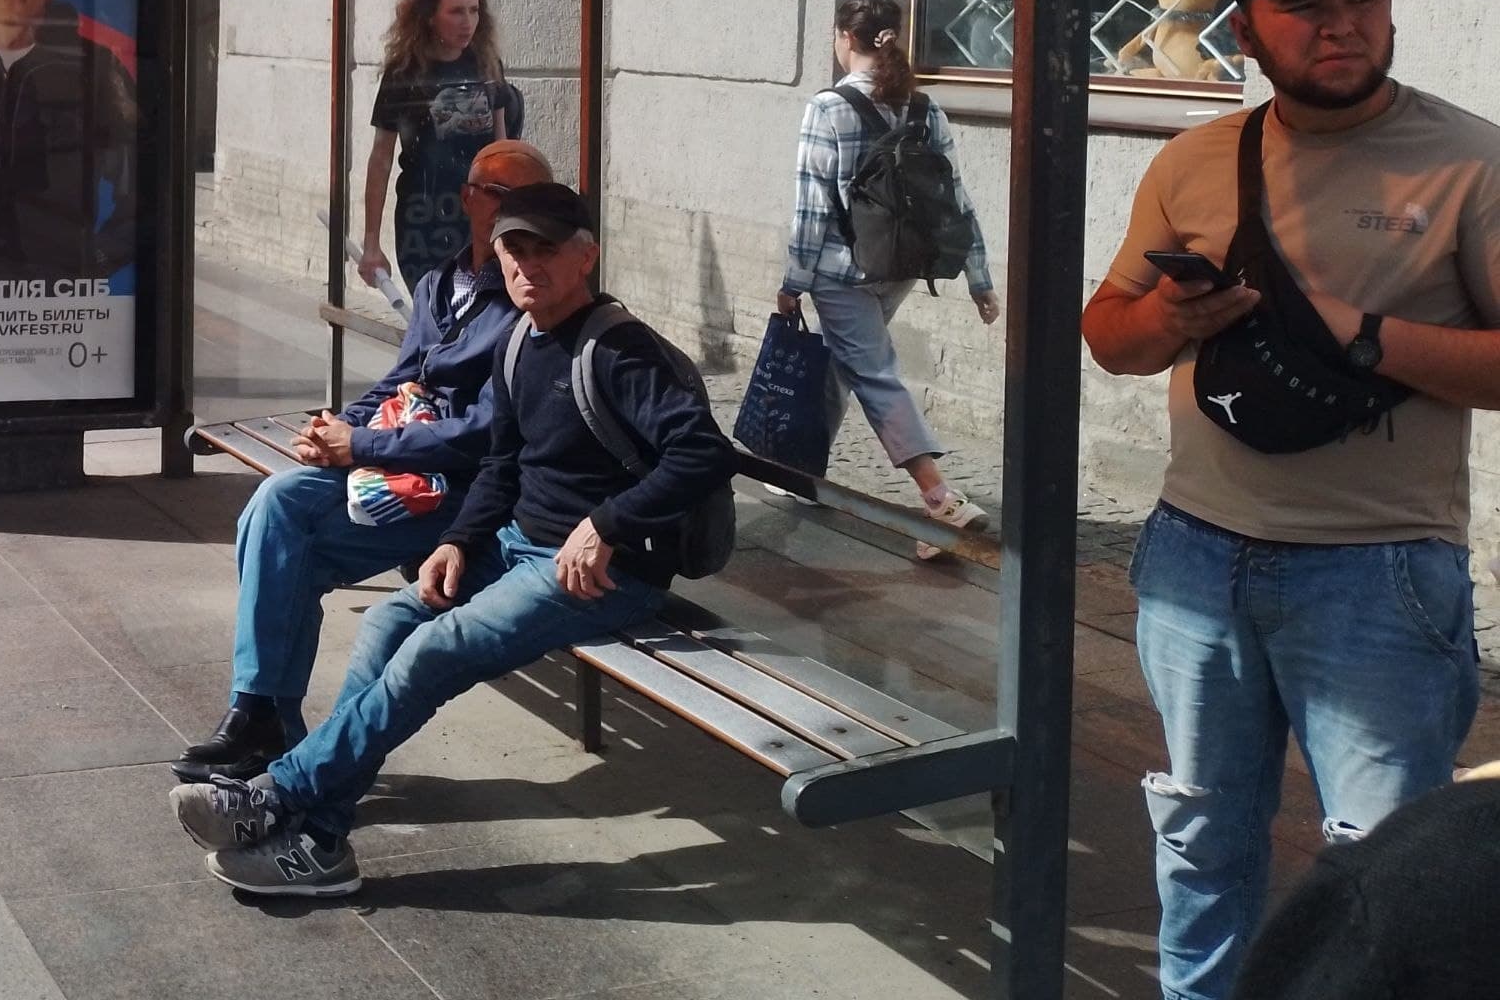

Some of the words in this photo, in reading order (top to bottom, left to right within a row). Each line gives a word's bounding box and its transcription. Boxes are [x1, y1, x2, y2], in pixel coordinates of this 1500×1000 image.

[53, 278, 111, 298] СПБ
[43, 308, 110, 322] БИЛЕТЫ
[67, 341, 108, 369] 0+
